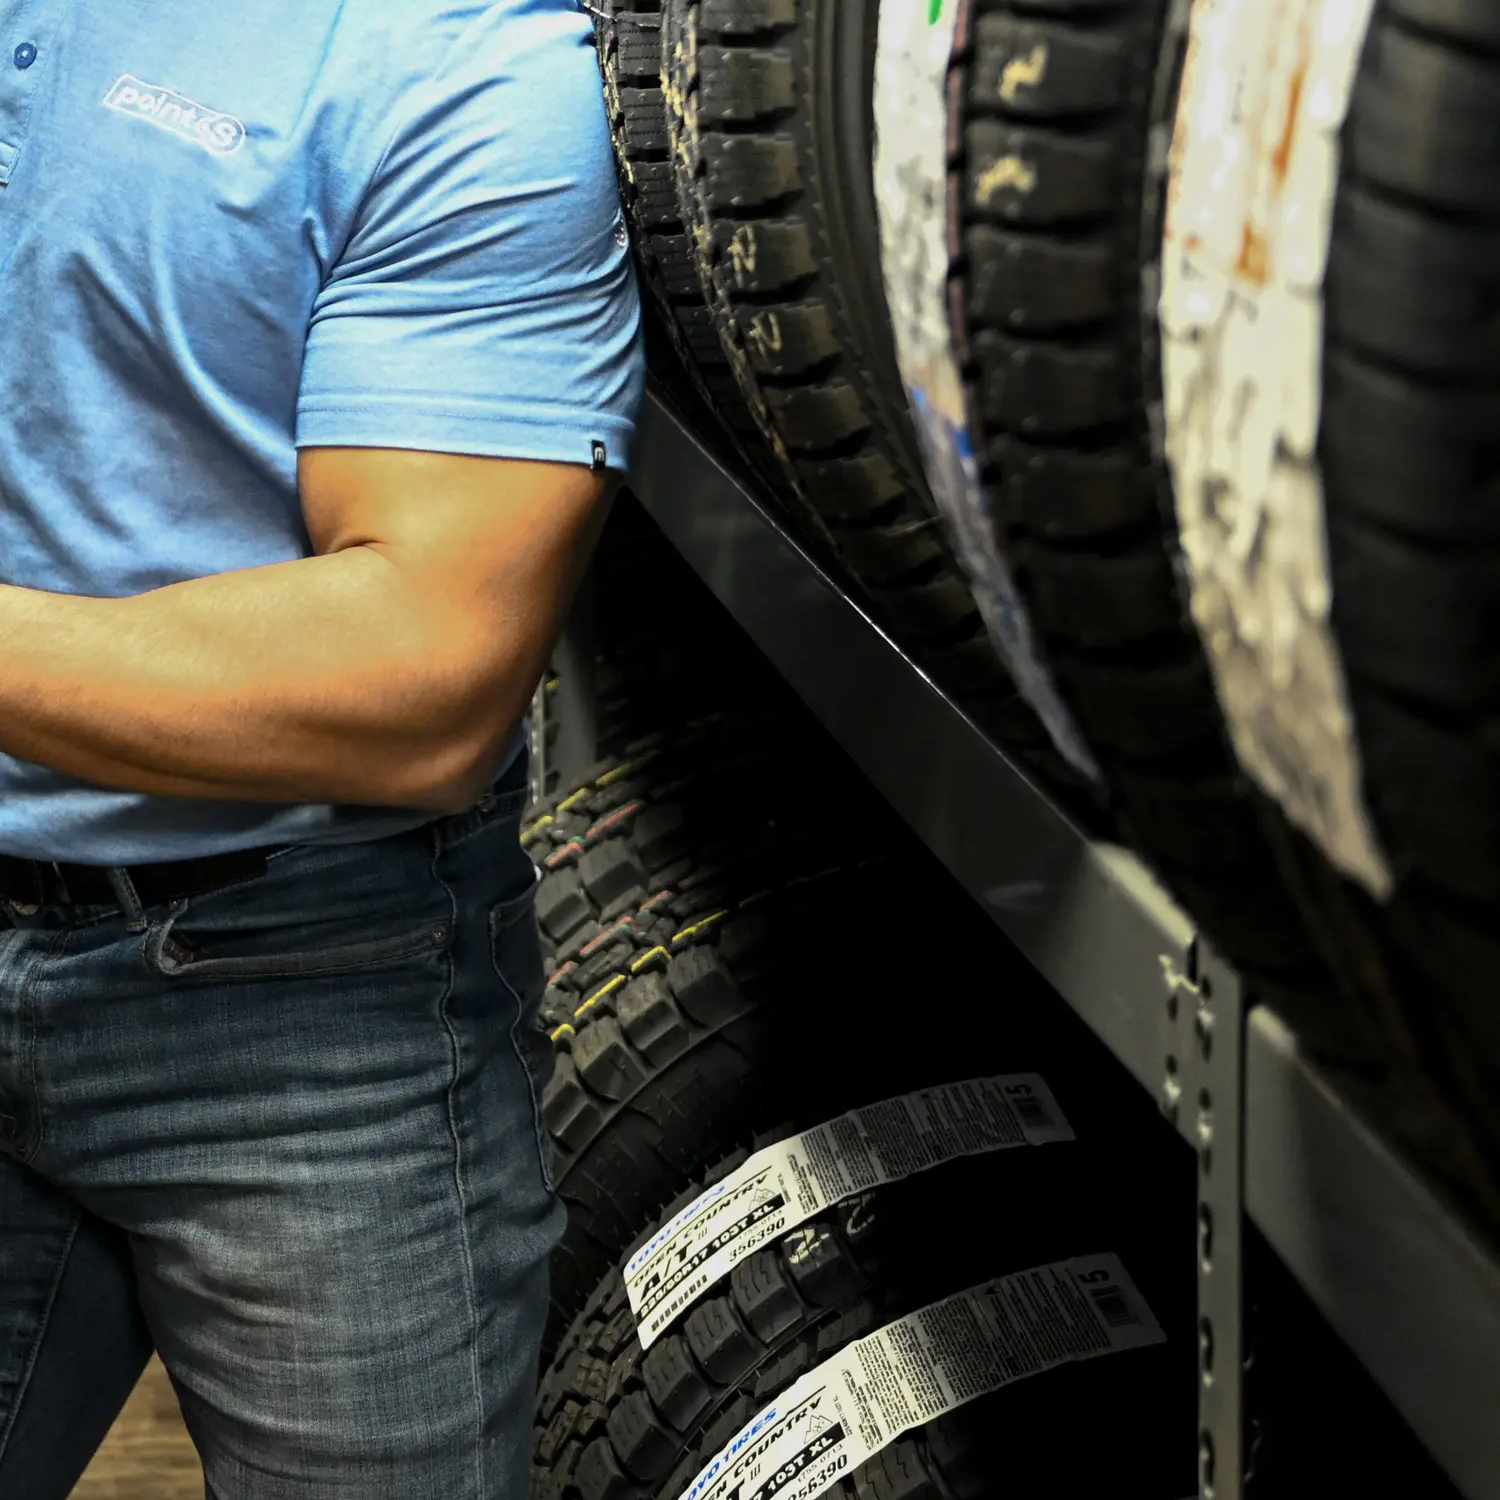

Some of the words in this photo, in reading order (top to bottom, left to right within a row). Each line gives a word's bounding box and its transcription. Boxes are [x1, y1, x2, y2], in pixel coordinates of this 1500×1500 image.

[633, 1242, 678, 1288] OPEN
[683, 1173, 768, 1239] COUNTRY
[712, 1216, 750, 1251] 103T
[750, 1200, 776, 1221] XL
[727, 1216, 787, 1263] 356390
[641, 1240, 692, 1303] A/T
[722, 1408, 778, 1463] TIRES
[733, 1396, 822, 1478] COUNTRY
[766, 1454, 810, 1492] 103T
[807, 1434, 835, 1455] XL
